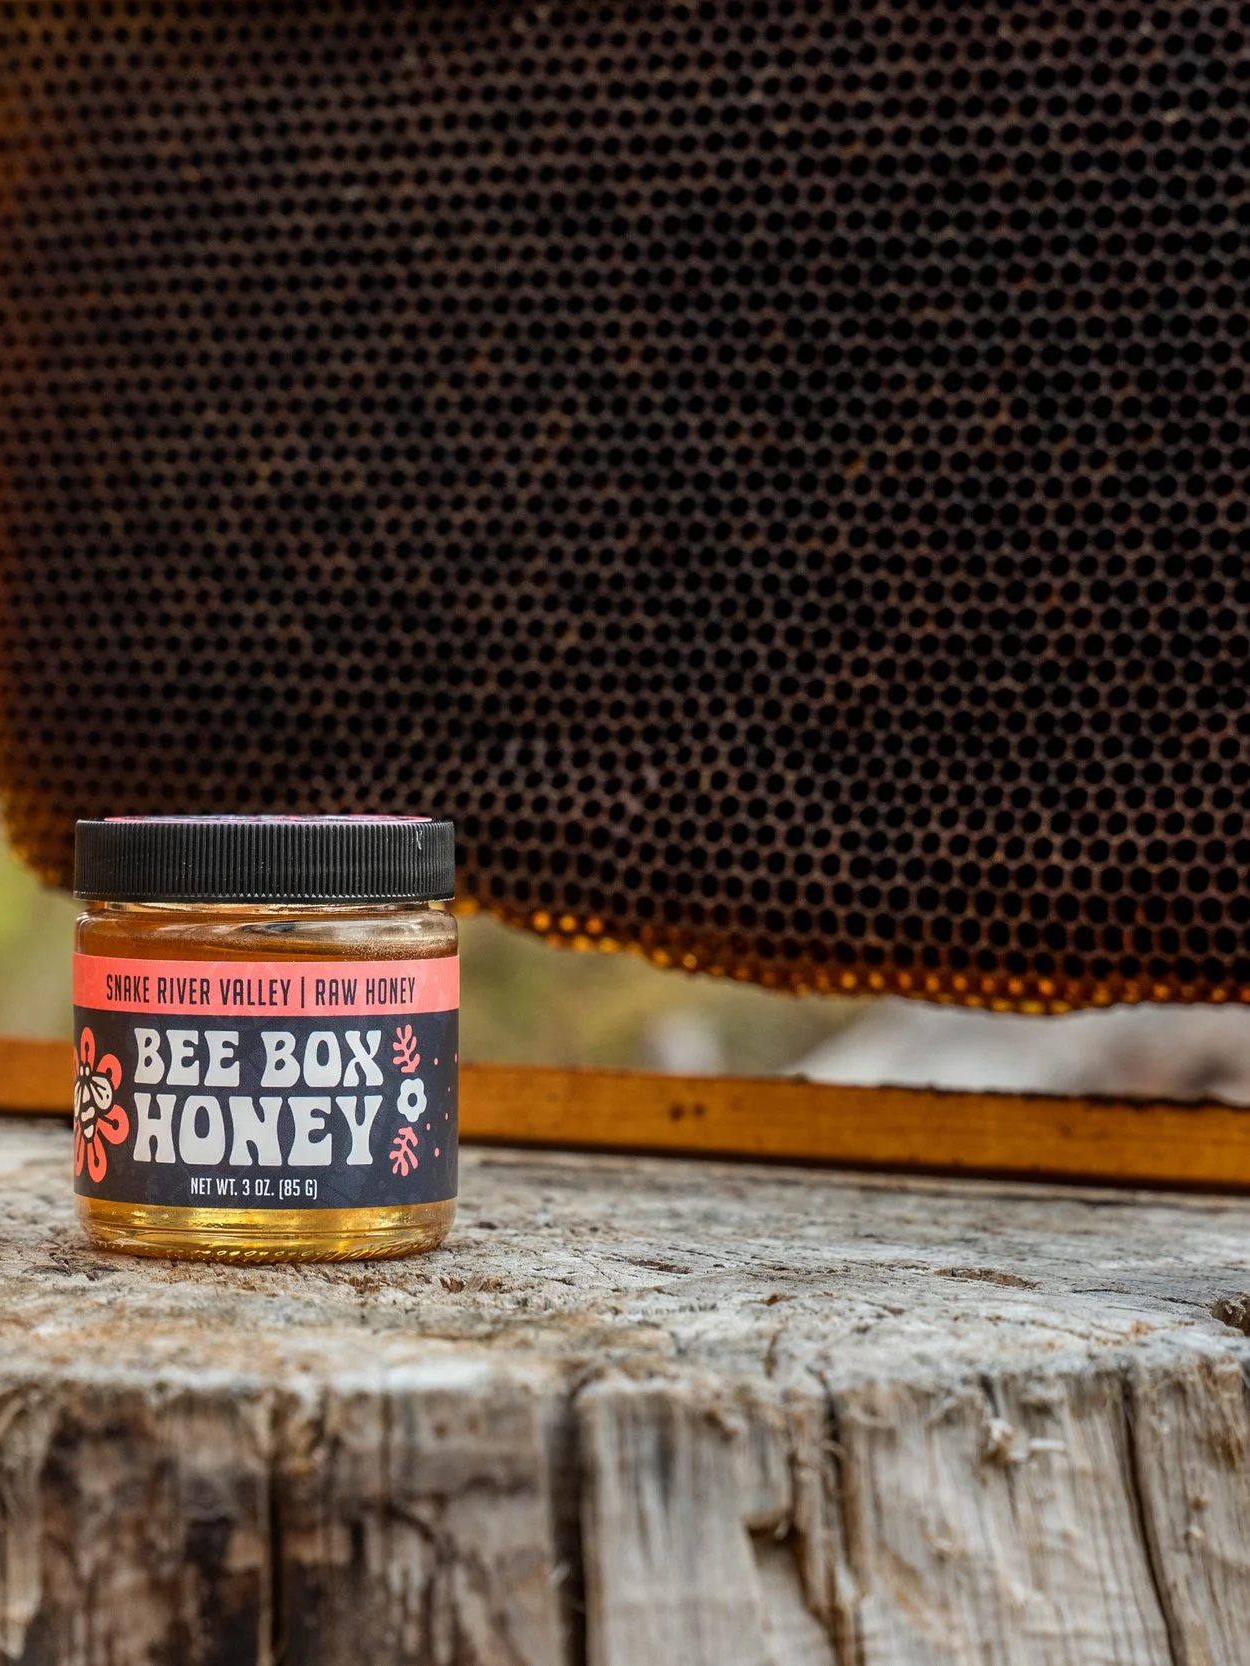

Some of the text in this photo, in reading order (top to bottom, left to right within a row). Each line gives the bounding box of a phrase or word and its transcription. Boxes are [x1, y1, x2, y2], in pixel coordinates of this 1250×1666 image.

[106, 974, 150, 1004] SNAKE
[157, 976, 211, 1005] RIVER
[219, 978, 292, 1006] VALLEY
[315, 978, 358, 1006] RAW
[365, 977, 416, 1006] HONEY
[134, 1027, 384, 1088] BEE BOX
[133, 1092, 384, 1167] HONEY
[190, 1177, 318, 1200] NET WT. 3 OZ. (85 G)
